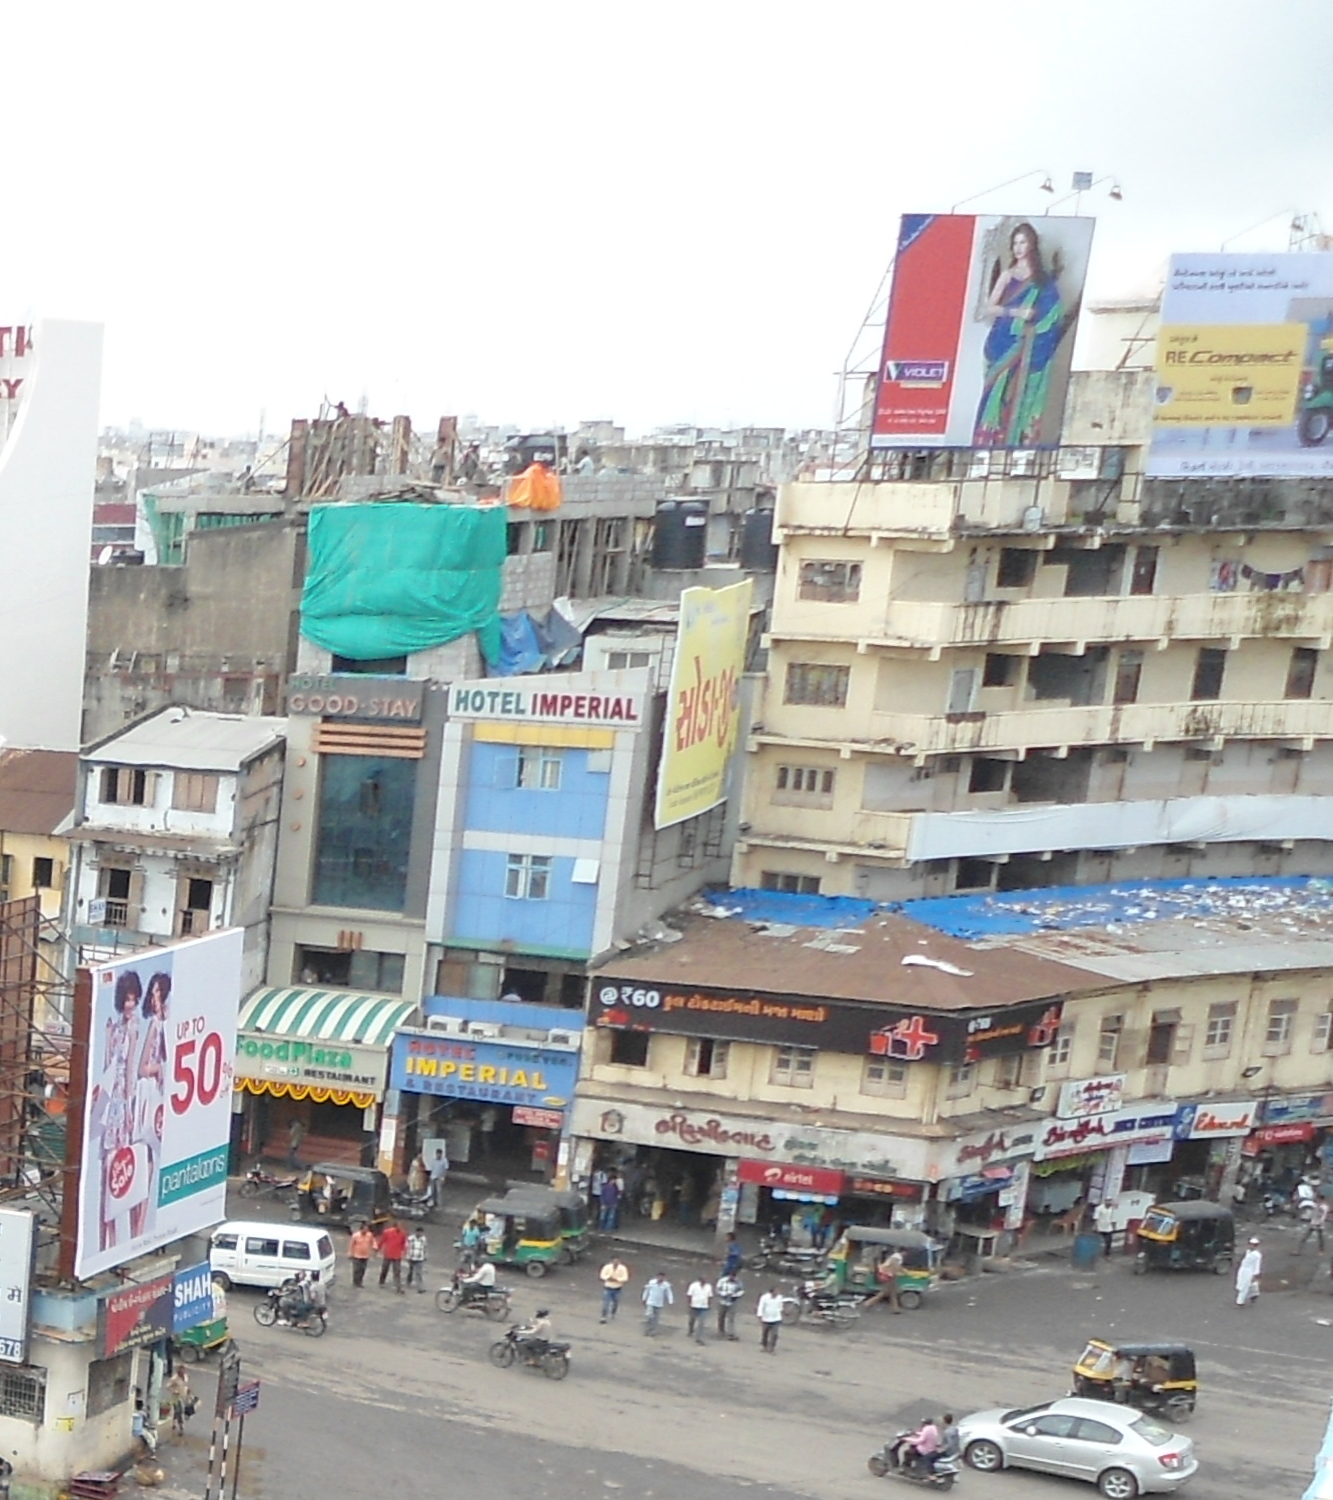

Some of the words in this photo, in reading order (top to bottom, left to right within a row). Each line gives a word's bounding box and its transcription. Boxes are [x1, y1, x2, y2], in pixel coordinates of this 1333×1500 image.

[1188, 349, 1299, 365] Compact
[454, 689, 527, 715] HOTEL
[531, 691, 638, 721] IMPERIAL
[176, 1022, 191, 1041] UP
[192, 1015, 205, 1034] TO
[407, 1039, 476, 1060] HOTEL
[170, 1030, 223, 1116] 50
[303, 1067, 378, 1086] RESTAURANT
[404, 1056, 548, 1091] IMPERIAL
[422, 1080, 537, 1102] RESTAURANT
[161, 1154, 225, 1200] pantaloons
[783, 1171, 814, 1186] airtel
[174, 1272, 212, 1307] SHAH
[173, 1302, 211, 1323] PUBLICITY
